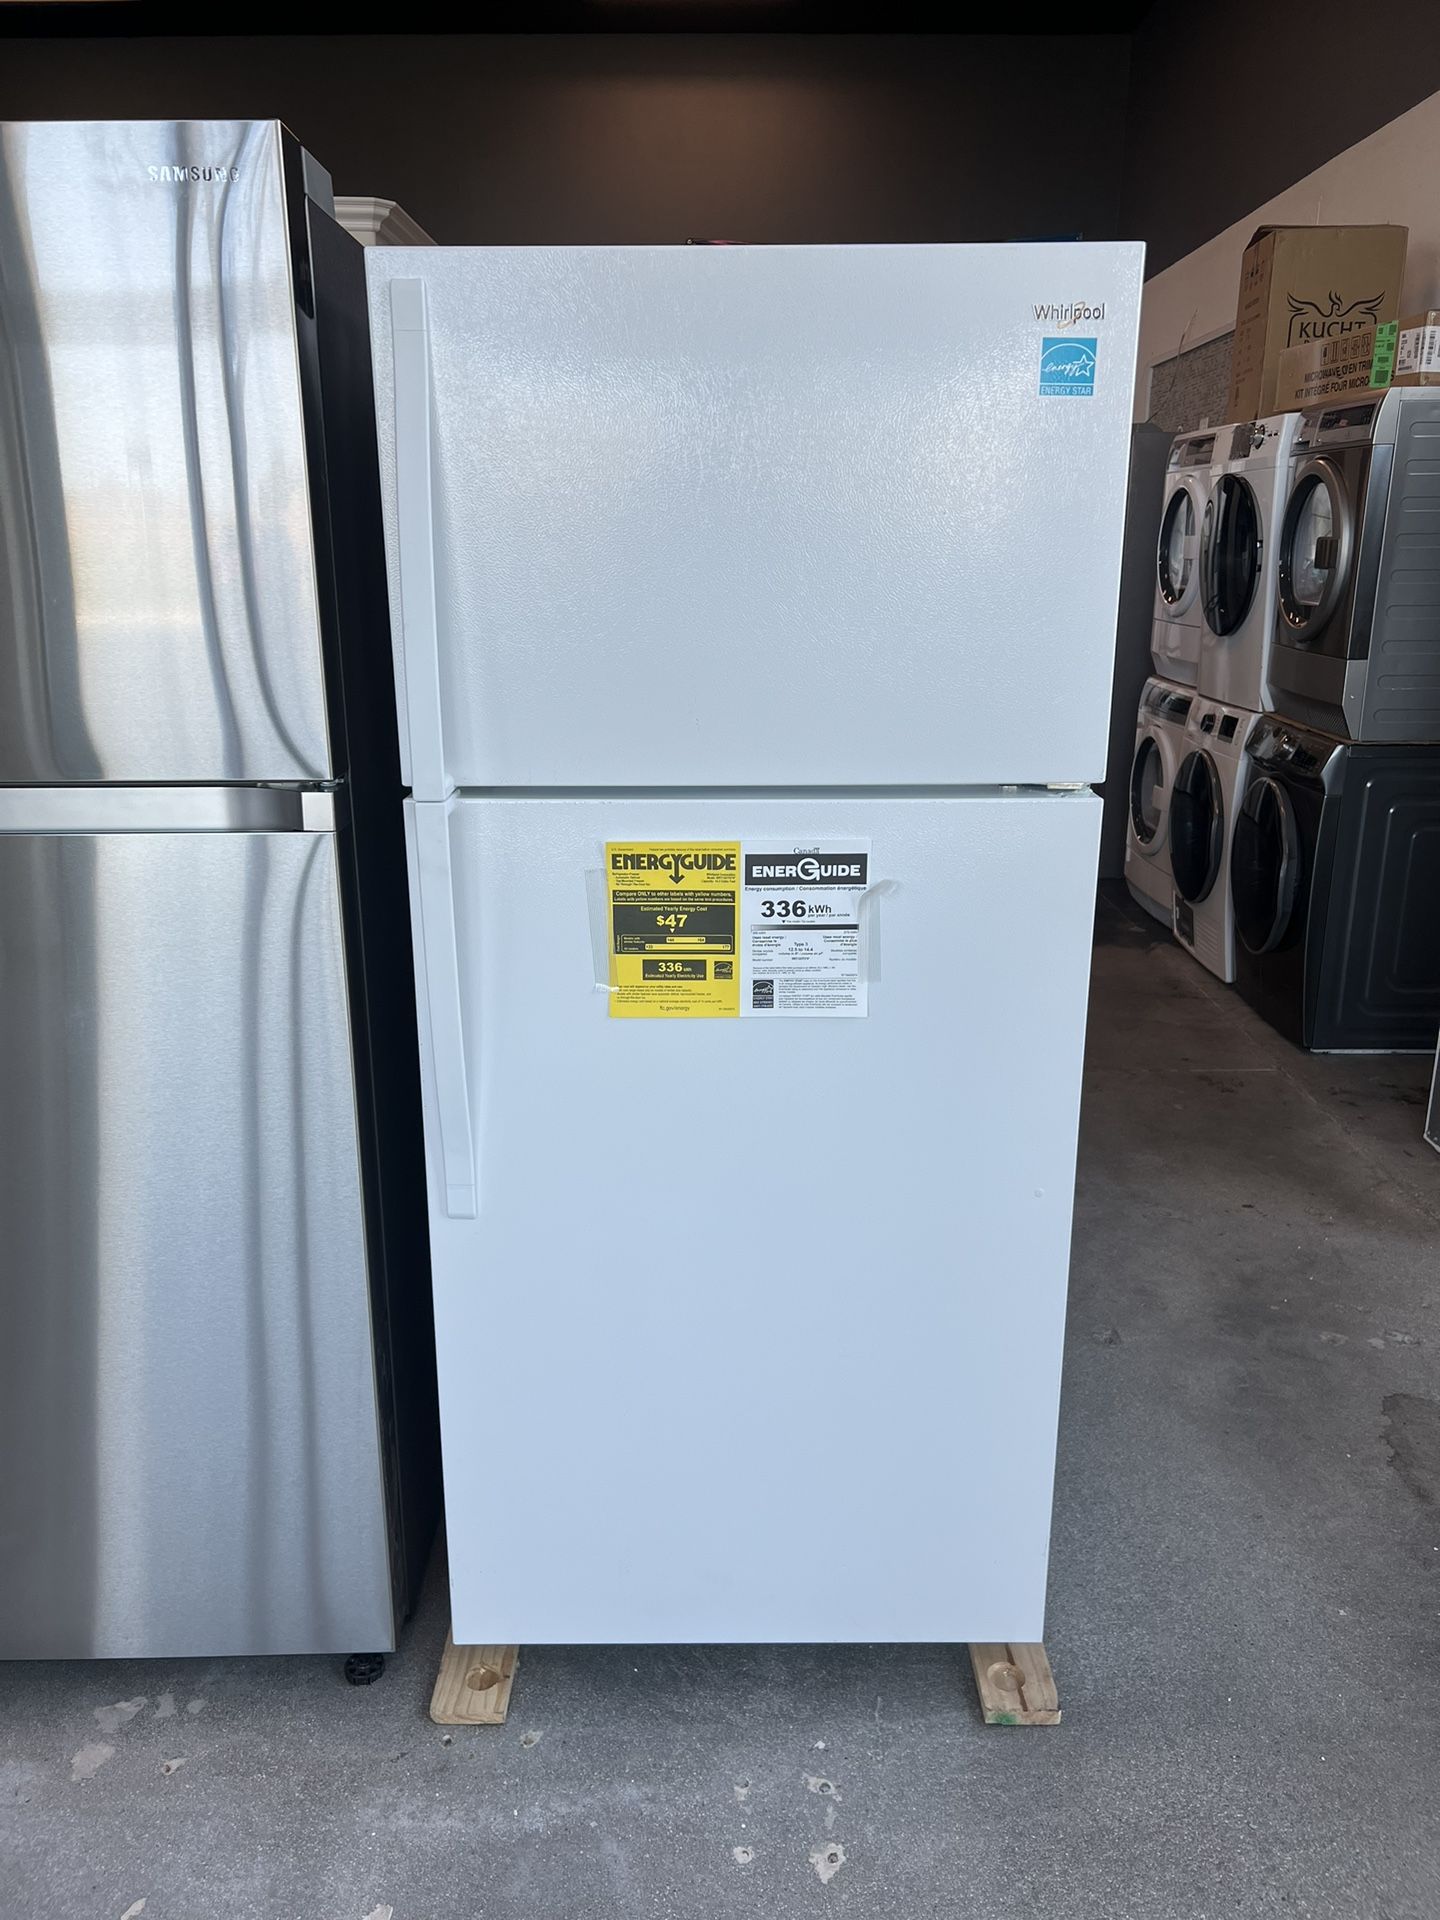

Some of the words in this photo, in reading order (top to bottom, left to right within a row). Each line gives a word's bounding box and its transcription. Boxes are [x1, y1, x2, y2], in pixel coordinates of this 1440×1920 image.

[147, 164, 240, 183] SAMSUNG
[1034, 302, 1105, 325] Whirlpool
[1299, 321, 1366, 338] KUCHT
[1040, 386, 1070, 395] ENERGY
[1072, 386, 1091, 395] STAR
[611, 853, 736, 871] ENERGYGUIDE
[752, 857, 861, 881] ENERGUIDE
[679, 905, 695, 913] Energy
[761, 900, 806, 918] 336
[808, 904, 832, 914] kWh
[656, 914, 688, 928] $47
[658, 962, 683, 972] 336
